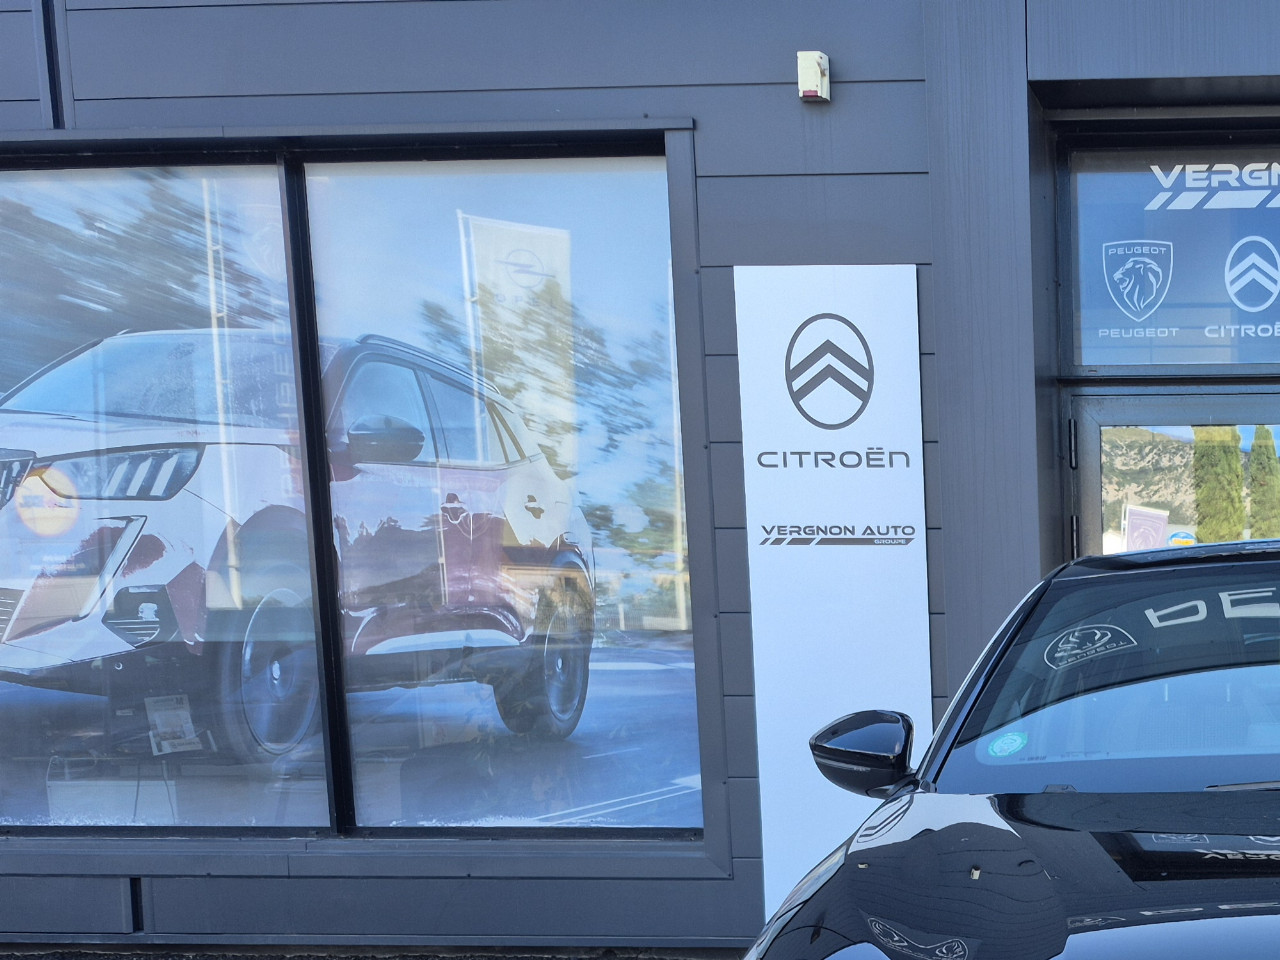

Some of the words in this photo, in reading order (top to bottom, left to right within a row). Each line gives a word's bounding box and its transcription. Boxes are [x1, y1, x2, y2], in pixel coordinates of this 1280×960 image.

[1107, 245, 1168, 256] PEUGEOT
[1097, 327, 1180, 339] PEUGEOT
[757, 446, 911, 468] CITROËN
[760, 525, 856, 536] VERGNON
[861, 524, 916, 536] AUTO
